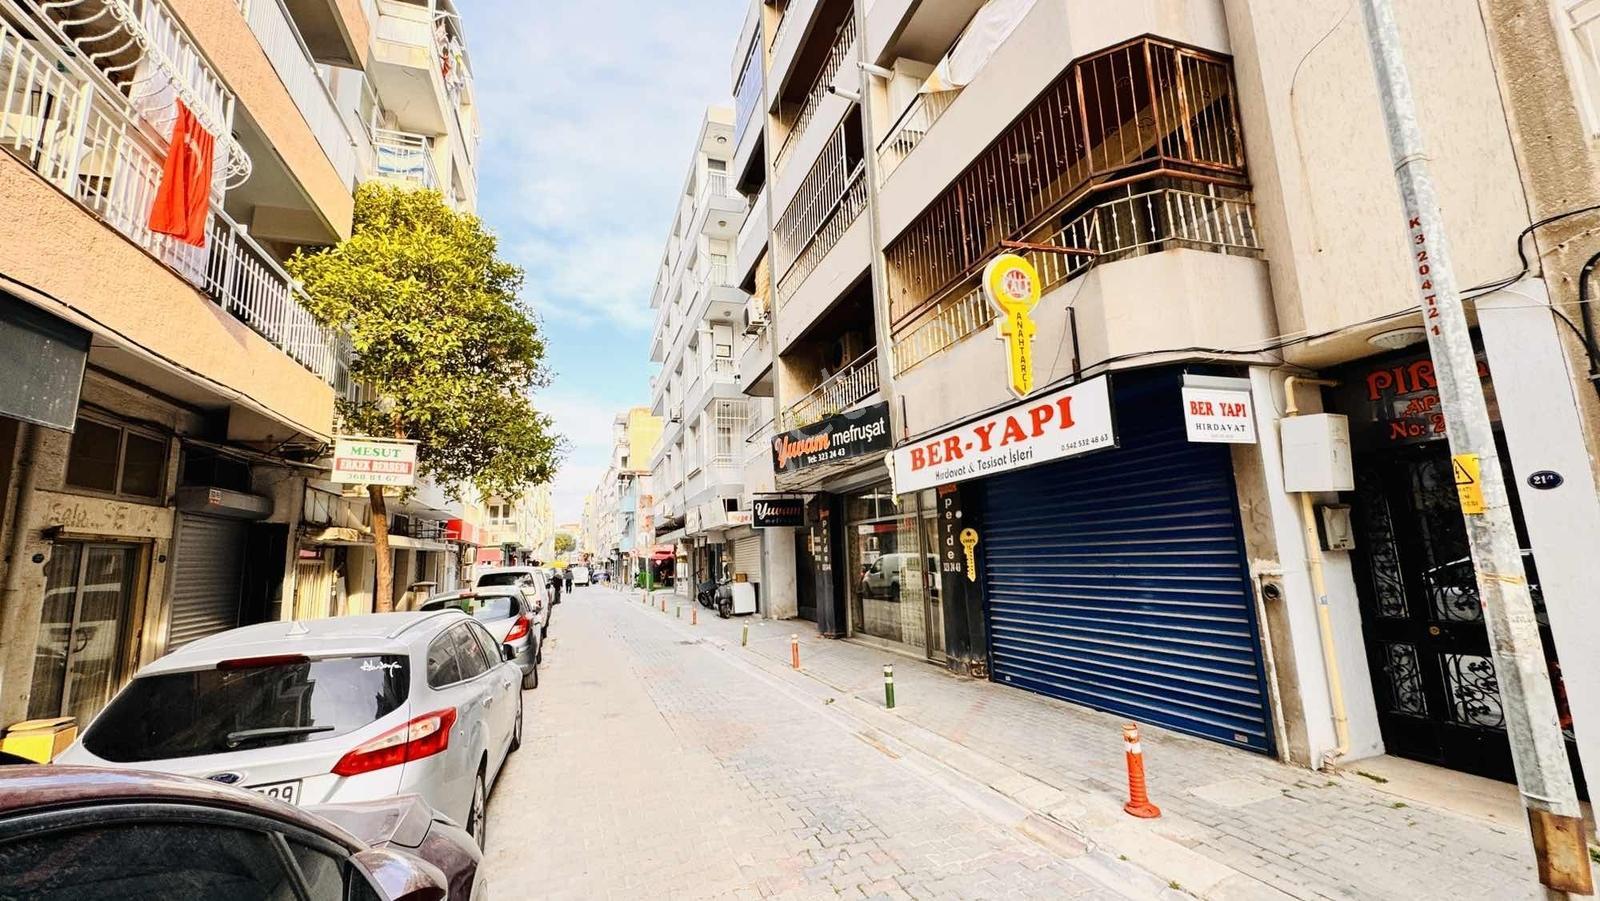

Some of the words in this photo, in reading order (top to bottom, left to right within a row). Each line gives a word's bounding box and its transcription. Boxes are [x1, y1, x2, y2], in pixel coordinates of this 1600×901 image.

[1016, 312, 1028, 391] ANAHTARCI
[1190, 401, 1214, 416] BER
[1219, 402, 1247, 418] YAPI
[1195, 423, 1247, 433] HIRDAVAT
[1431, 414, 1446, 433] 2
[775, 434, 830, 469] Yuvam
[832, 417, 886, 445] mefruşat
[910, 396, 1076, 471] BER-YAPI
[351, 446, 401, 457] MESUT
[818, 452, 829, 461] 323
[968, 463, 976, 474] &
[978, 455, 1007, 471] Tesisat
[1009, 446, 1034, 465] İşleri
